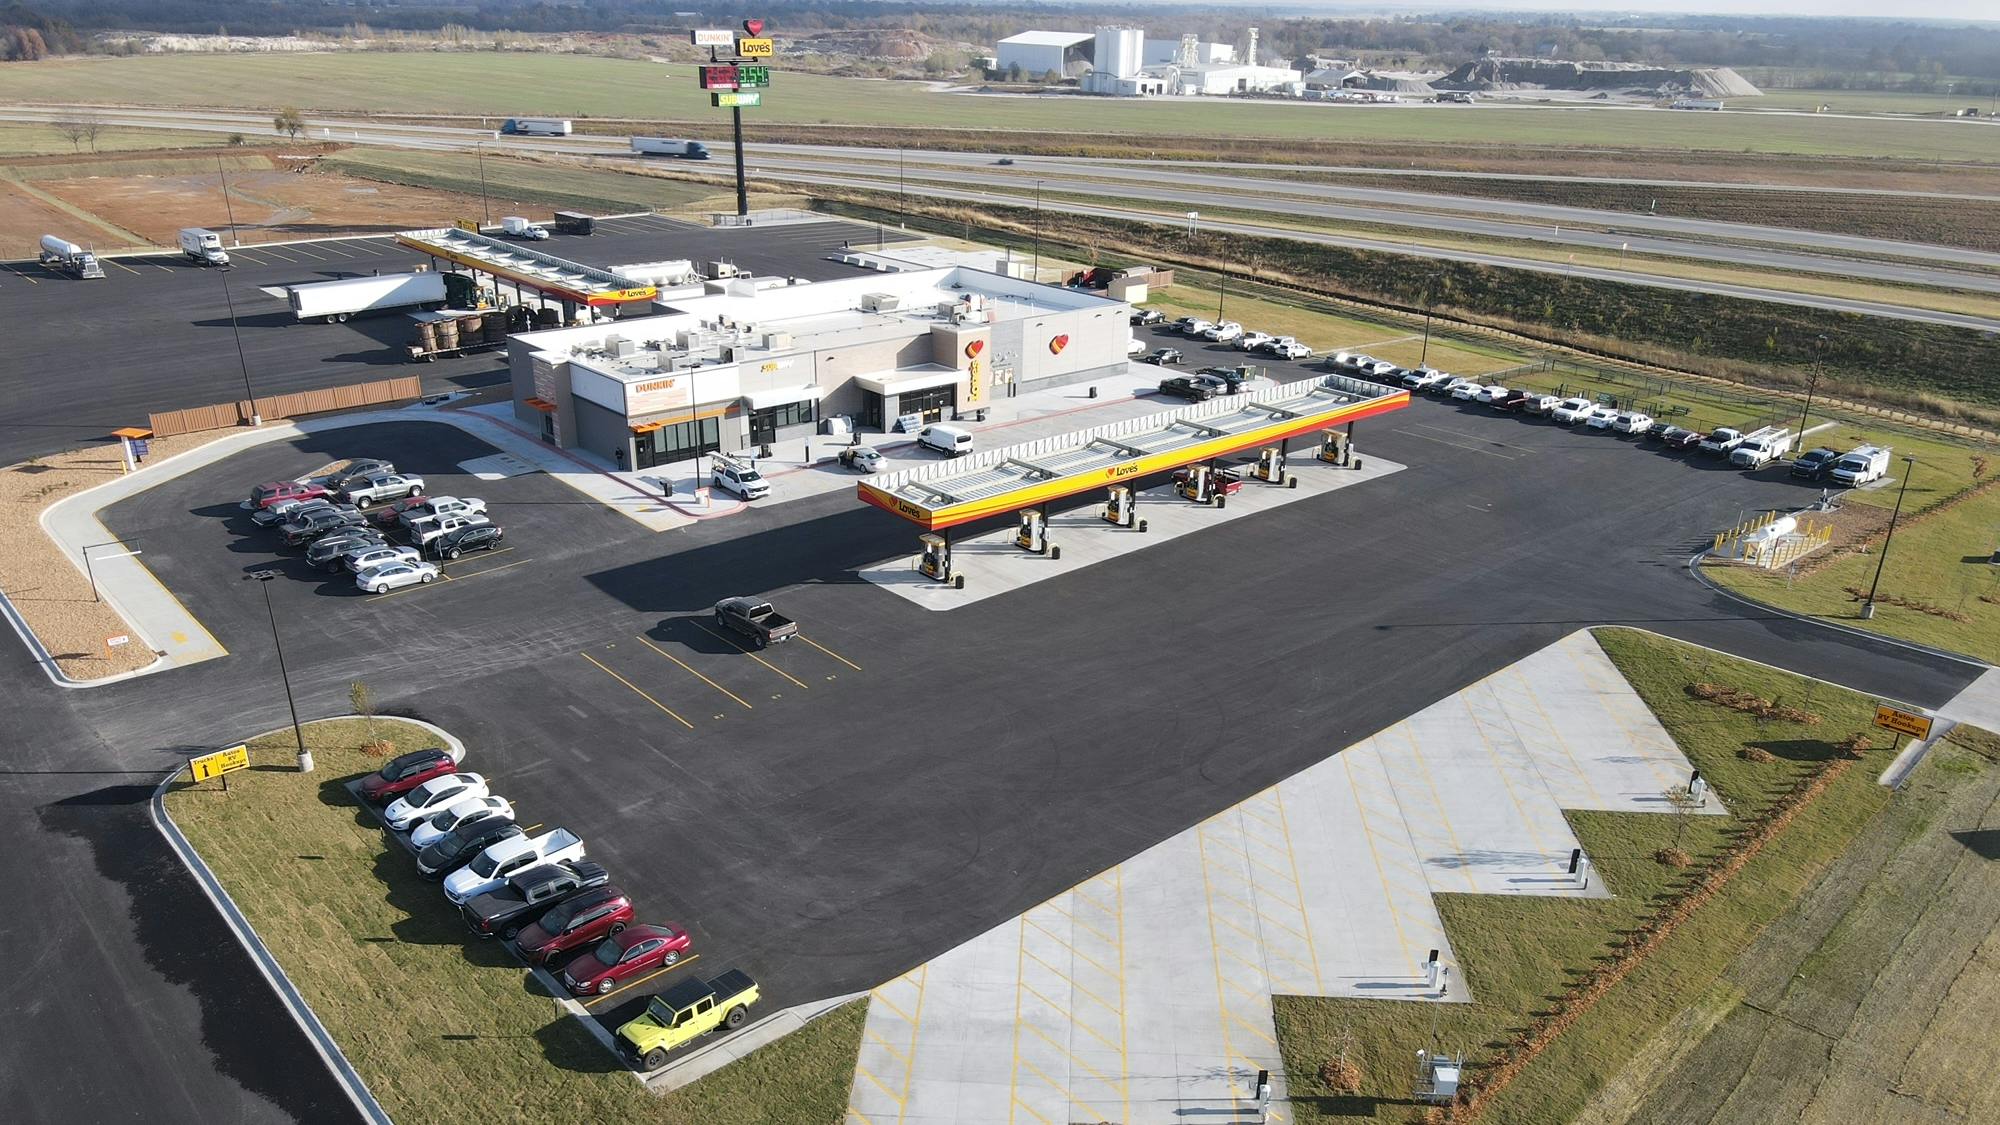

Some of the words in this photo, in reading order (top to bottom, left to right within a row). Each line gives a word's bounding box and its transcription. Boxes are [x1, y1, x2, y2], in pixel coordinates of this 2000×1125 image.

[742, 41, 771, 53] Love's
[719, 94, 758, 105] SUBWAY
[1116, 462, 1138, 477] Love's
[899, 500, 920, 519] Love's
[1892, 711, 1915, 722] Autos
[1877, 713, 1890, 721] RV
[1891, 717, 1926, 733] Hookups
[193, 757, 214, 765] Trucks
